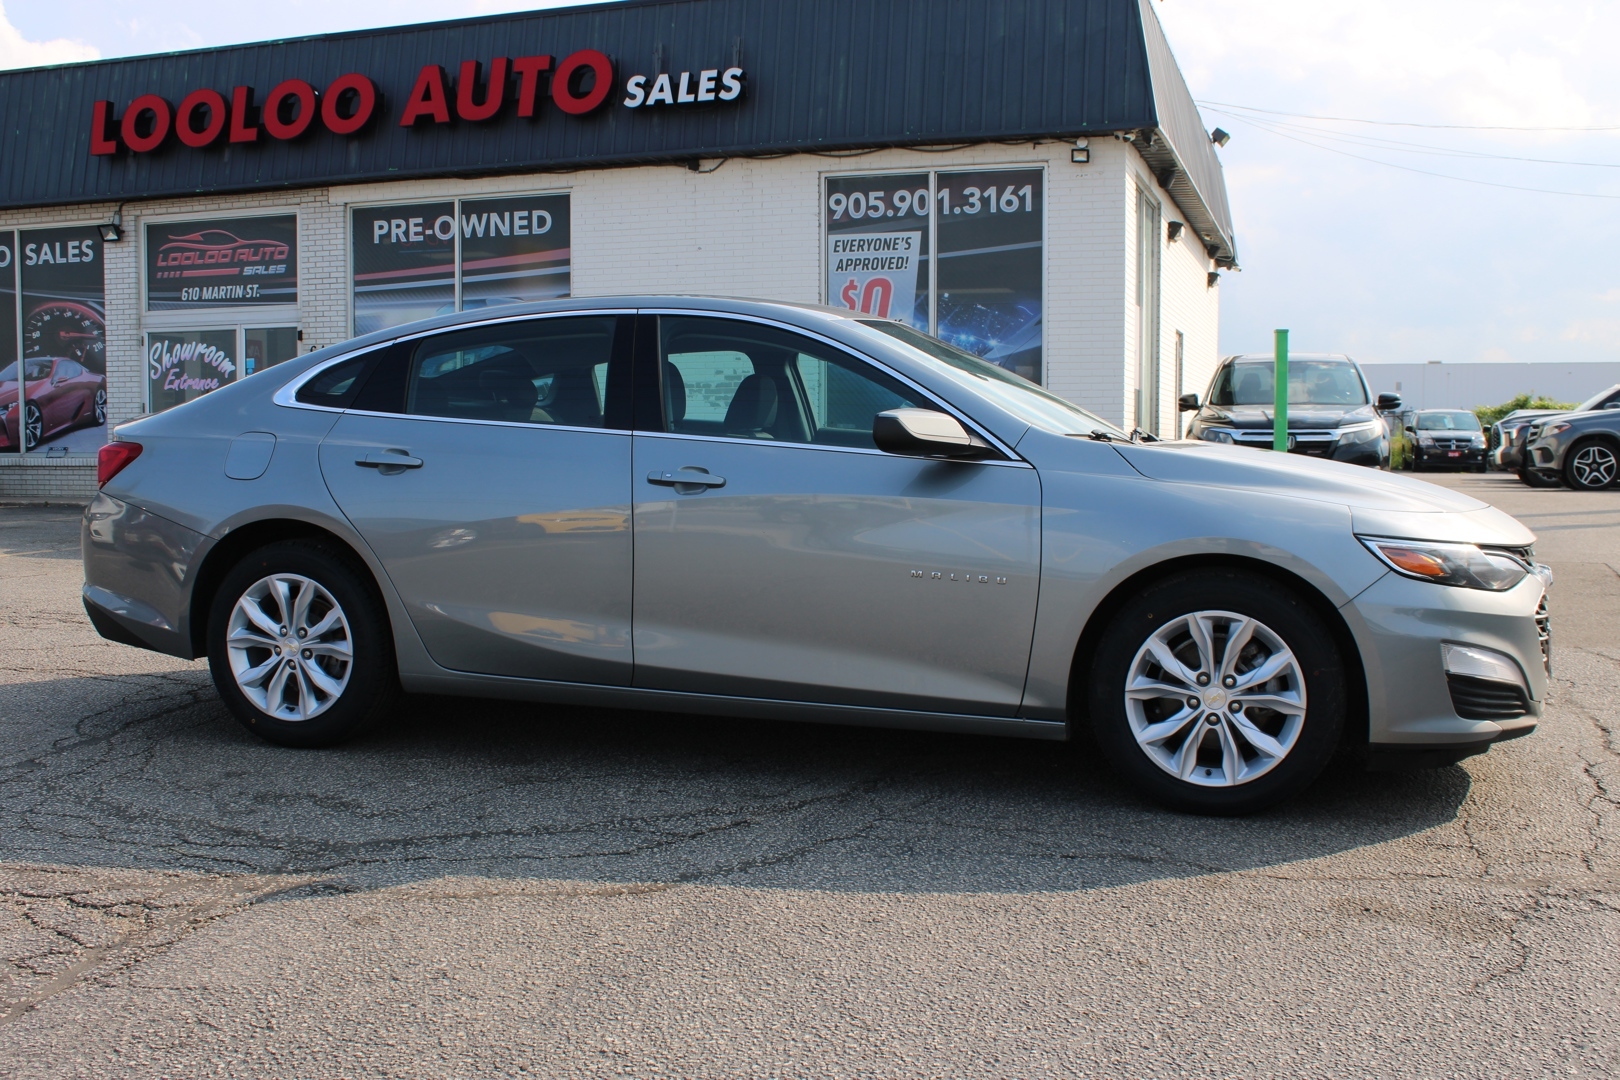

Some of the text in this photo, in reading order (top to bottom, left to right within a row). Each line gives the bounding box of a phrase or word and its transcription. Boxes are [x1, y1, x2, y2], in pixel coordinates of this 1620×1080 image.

[90, 48, 744, 156] LOOLOO AUTO SALES
[828, 184, 1033, 220] 905.901.3161
[373, 209, 552, 244] PRE-OWNED
[25, 239, 94, 266] SALES
[833, 236, 912, 254] EVERYONE'S
[156, 246, 289, 267] LOOLOO AUTO
[835, 256, 910, 272] APPROVED!
[242, 264, 287, 276] SALES
[181, 284, 260, 301] 610 MARTIN ST.
[149, 340, 236, 379] Showroom
[164, 368, 219, 391] Entrance
[910, 570, 1007, 585] MALIBU
